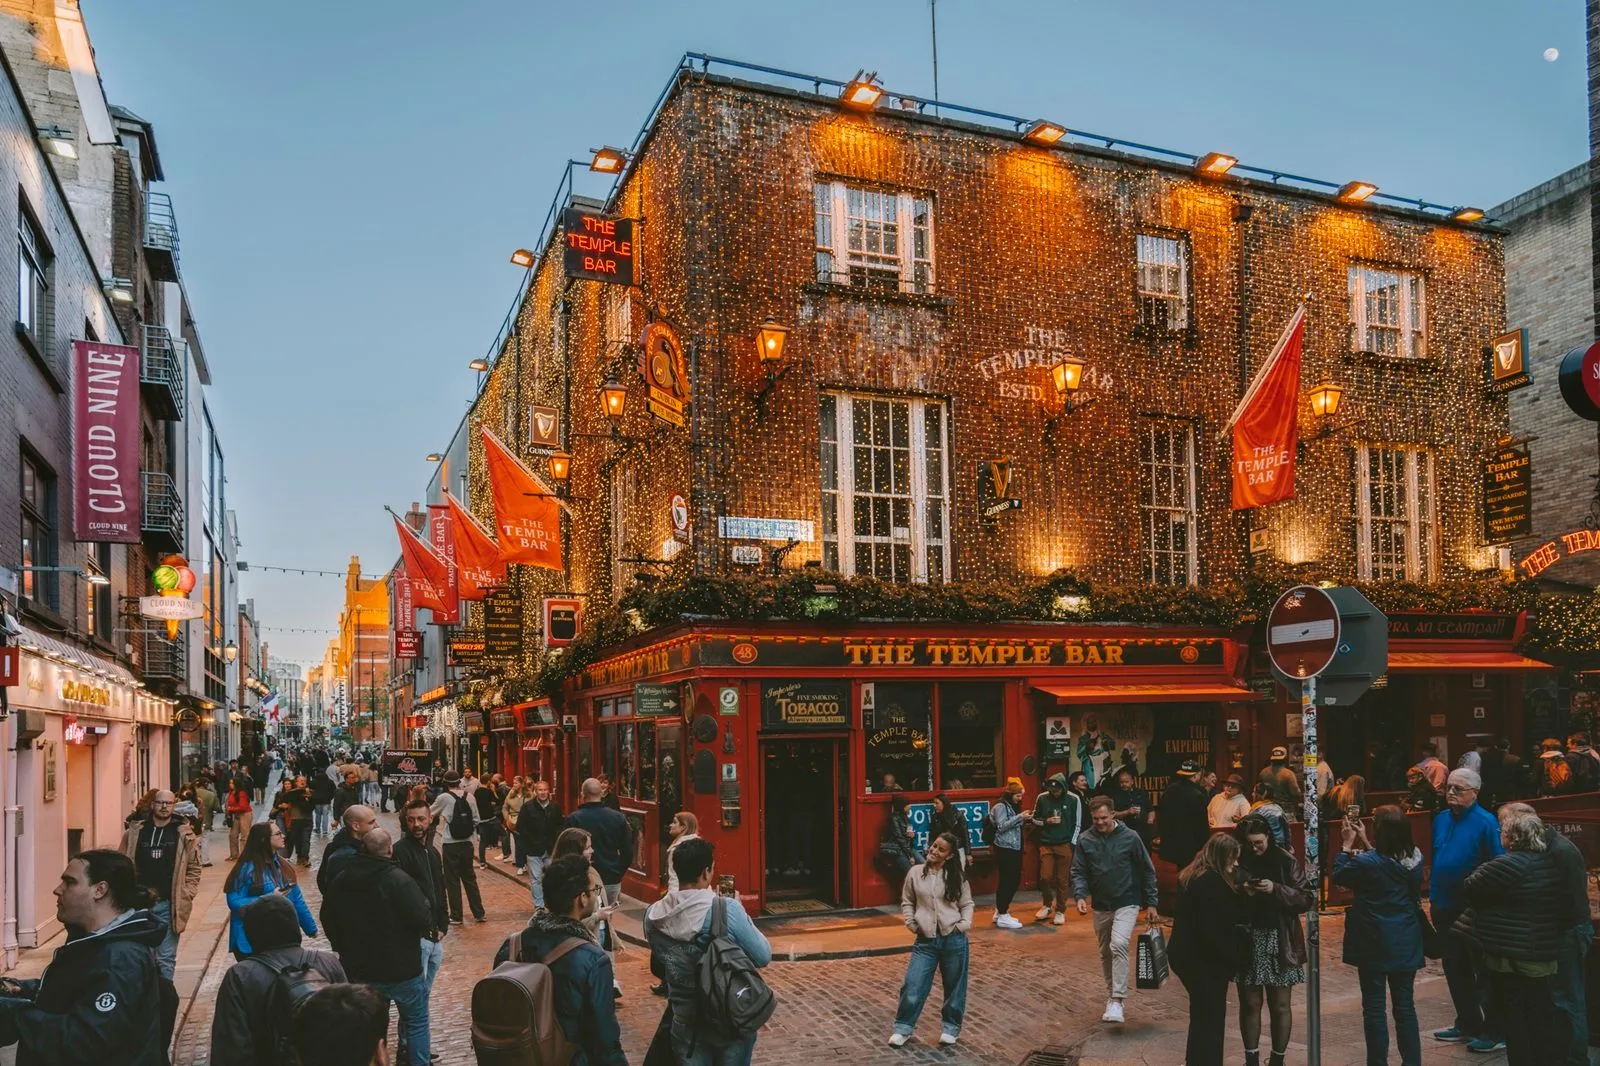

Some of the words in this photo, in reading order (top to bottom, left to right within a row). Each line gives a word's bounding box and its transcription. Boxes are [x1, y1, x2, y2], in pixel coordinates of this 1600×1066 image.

[582, 216, 615, 235] THE
[567, 233, 631, 256] TEMPLE
[584, 256, 616, 274] BAR
[1024, 325, 1067, 349] THE
[88, 350, 126, 416] NINE
[998, 381, 1043, 401] ESTD
[1492, 374, 1529, 393] GUINNESS
[653, 402, 665, 416] LIVE
[665, 409, 683, 424] MUSIC
[1253, 444, 1276, 458] THE
[1500, 452, 1515, 461] THE
[88, 424, 127, 513] CLOUD
[1236, 450, 1290, 474] TEMPLE
[1486, 456, 1530, 473] TEMPLE
[1248, 469, 1275, 486] BAR
[1495, 470, 1519, 482] BAR
[1503, 490, 1528, 500] GARDEN
[986, 500, 1010, 517] GUINNESS
[88, 521, 111, 530] CLOUD
[111, 522, 128, 532] NINE
[520, 518, 543, 529] THE
[1488, 518, 1503, 526] LIVE
[1503, 514, 1527, 523] MUSIC
[1496, 522, 1517, 532] DAILY
[436, 521, 445, 542] BAR
[502, 525, 559, 543] TEMPLE
[520, 539, 549, 552] BAR
[1520, 541, 1560, 577] THE
[403, 583, 411, 598] THE
[150, 599, 175, 608] CLOUD
[176, 600, 196, 610] NINE
[486, 597, 520, 606] TEMPLE
[494, 606, 513, 614] BAR
[404, 599, 412, 628] TEMPLE
[736, 646, 753, 659] 48
[846, 645, 915, 665] THE
[926, 645, 1051, 665] TEMPLE
[1064, 645, 1124, 665] BAR
[590, 665, 606, 686] THE
[608, 658, 643, 682] TEMPLE
[647, 649, 669, 675] BAR
[765, 682, 802, 698] Importers
[775, 698, 839, 720] TOBACCO
[868, 726, 908, 747] TEMPLE
[1189, 725, 1209, 739] THE
[1164, 739, 1210, 753] EMPEROR
[1197, 754, 1209, 768] OF
[1133, 775, 1170, 791] MALTE
